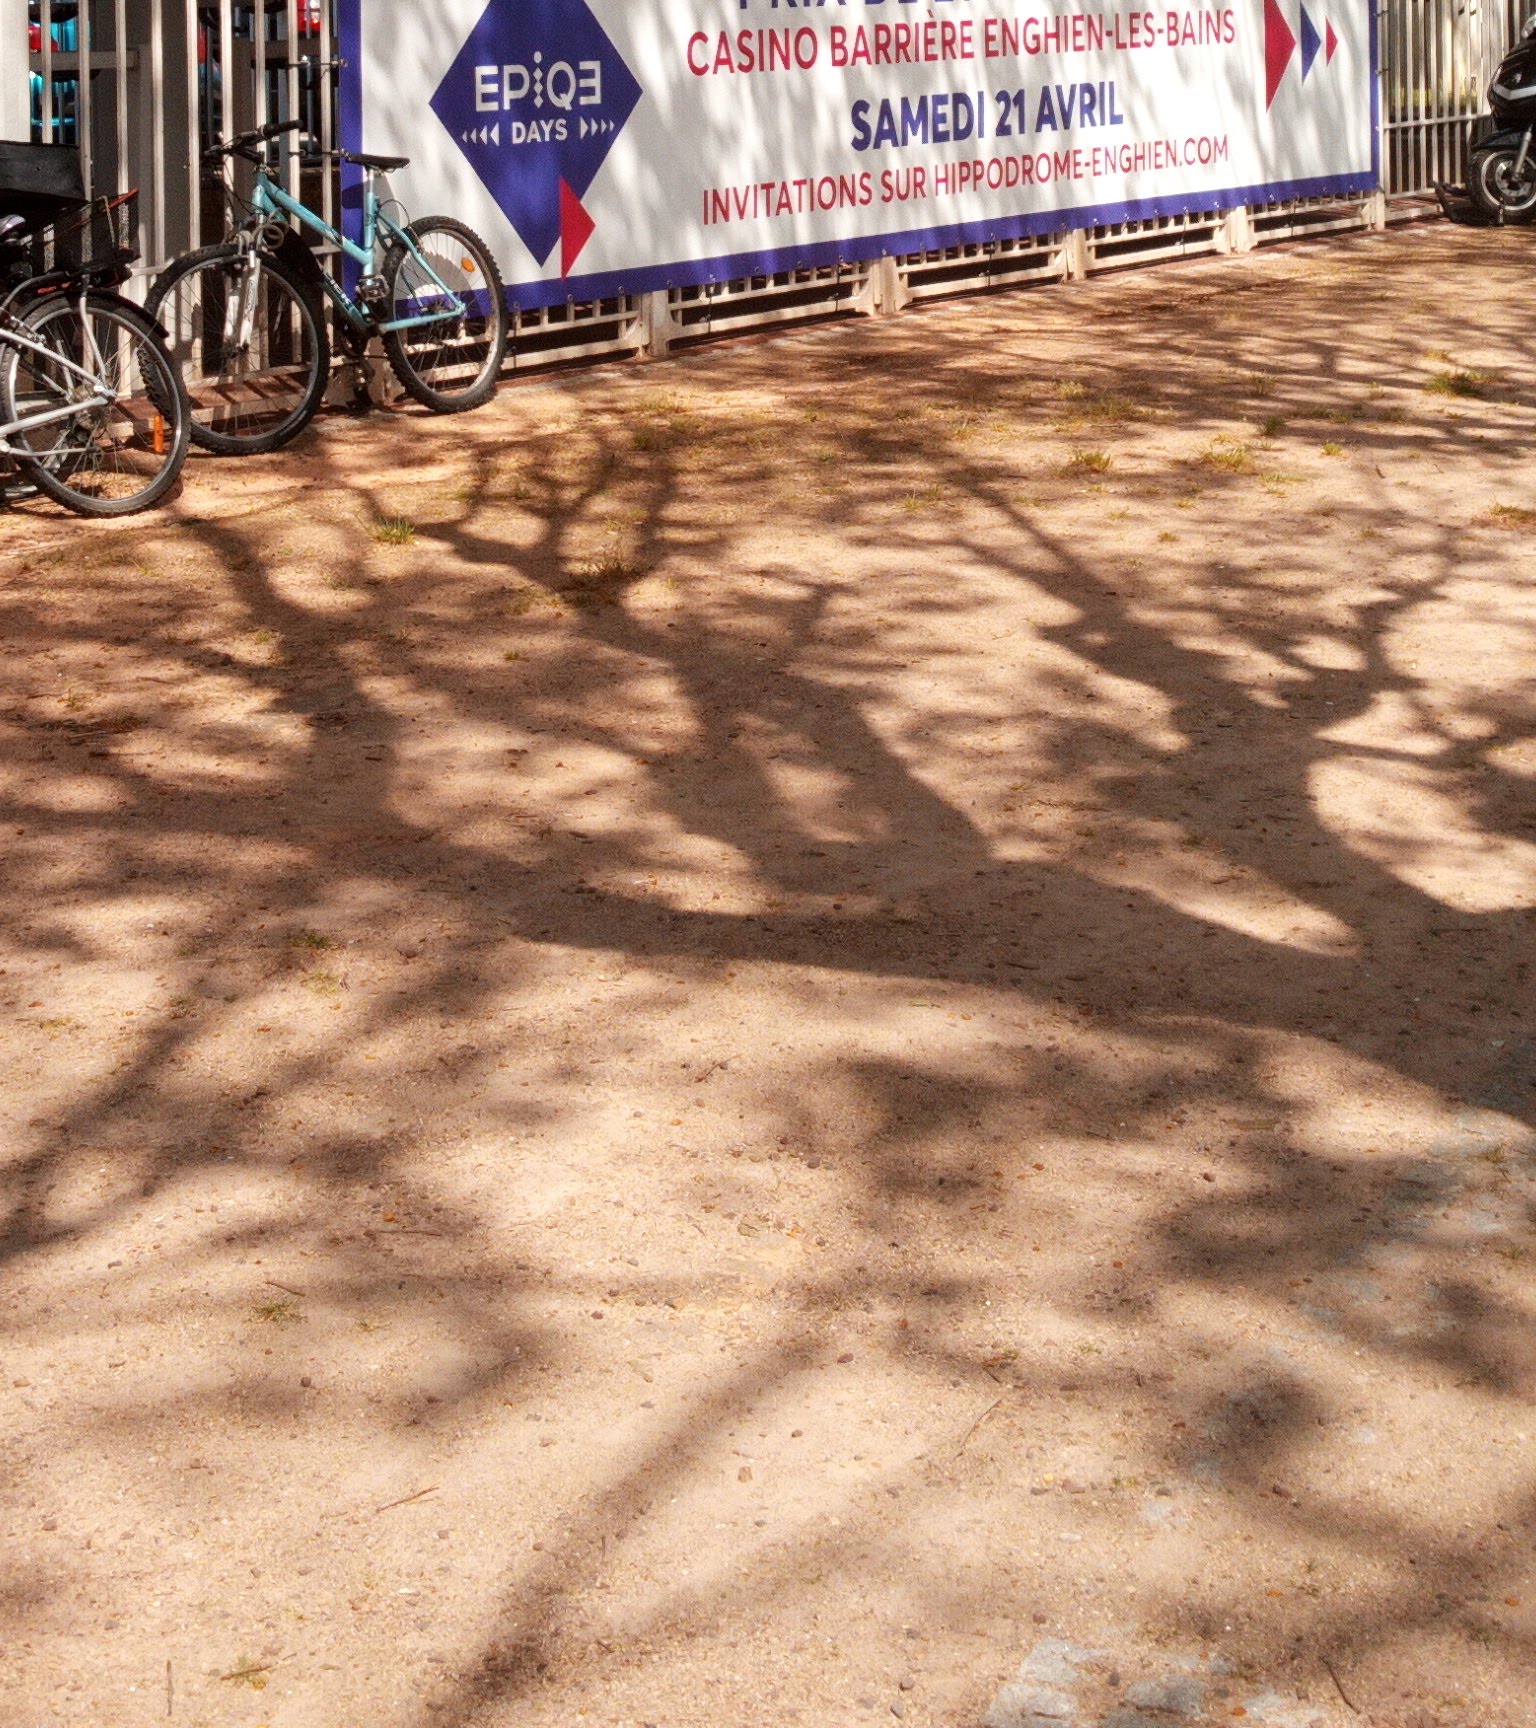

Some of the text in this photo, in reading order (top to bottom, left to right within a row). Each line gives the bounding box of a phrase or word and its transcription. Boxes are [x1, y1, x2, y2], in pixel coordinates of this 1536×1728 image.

[686, 8, 1236, 77] CASINO BARRIÈRE ENGHIEN-LES-BAINS
[511, 118, 569, 145] DAYS
[850, 80, 1124, 152] SAMEDI 21 AVRIL
[702, 134, 1229, 226] INVITATIONS SUR HIPPODROME-ENGHIEN.COM
